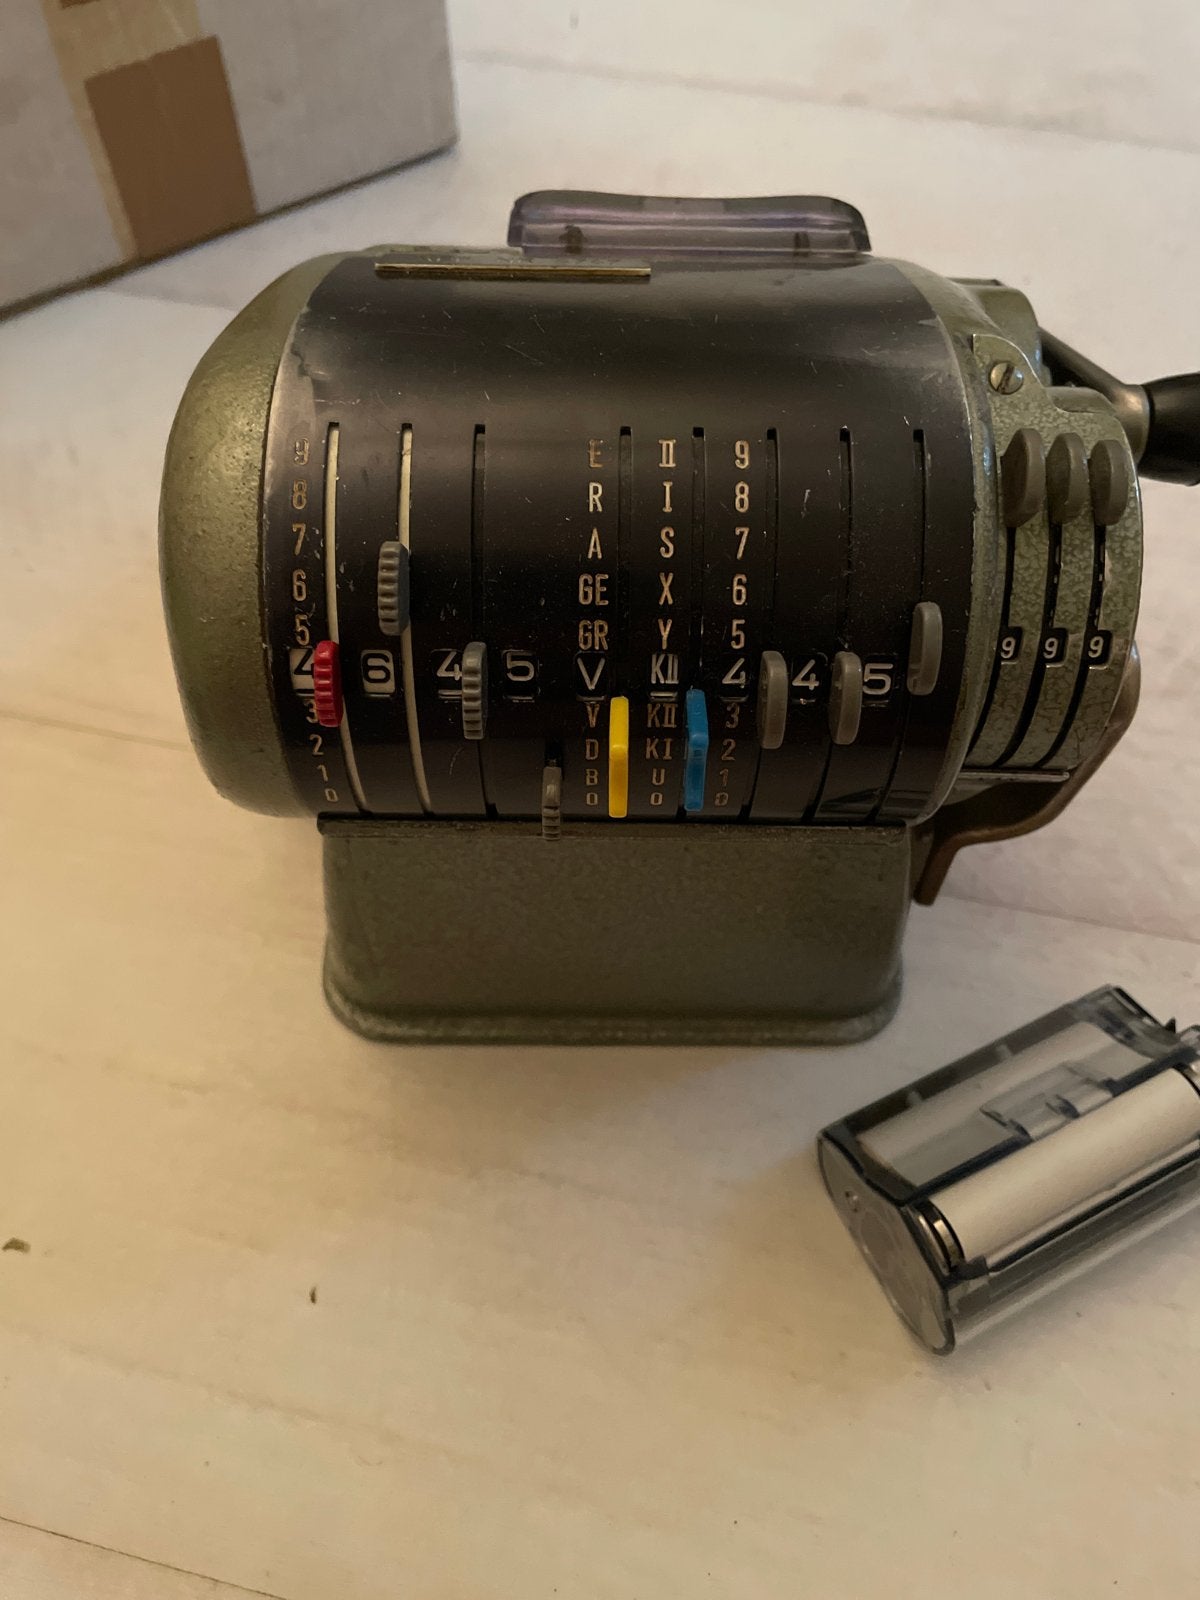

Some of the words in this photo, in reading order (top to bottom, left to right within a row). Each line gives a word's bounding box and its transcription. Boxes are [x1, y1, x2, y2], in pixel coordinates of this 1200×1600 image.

[293, 438, 310, 465] 9
[588, 439, 604, 468] E
[734, 440, 750, 469] 9
[292, 479, 308, 509] 8
[588, 482, 603, 512] R
[662, 480, 673, 513] I
[734, 480, 749, 513] 8
[292, 523, 306, 556] 7
[587, 527, 603, 559] A
[659, 526, 675, 558] S
[735, 527, 750, 560] 7
[292, 569, 307, 602] 6
[578, 573, 609, 606] GE
[658, 572, 674, 605] X
[732, 573, 747, 606] 6
[294, 614, 310, 646] 5
[578, 619, 609, 650] GR
[657, 618, 673, 650] Y
[730, 619, 746, 650] 5
[1000, 636, 1016, 659] 9
[1043, 637, 1059, 659] 9
[1088, 635, 1104, 658] 9
[363, 653, 391, 683] 6
[436, 651, 463, 681] 4
[506, 651, 535, 681] 5
[577, 657, 606, 690] V
[721, 658, 747, 688] 4
[791, 659, 820, 691] 4
[862, 663, 894, 695] 5
[584, 702, 600, 728] V
[725, 702, 740, 728] 3
[309, 734, 323, 756] 2
[585, 738, 599, 760] D
[721, 738, 736, 761] 2
[317, 764, 328, 782] 1
[585, 768, 599, 786] B
[651, 768, 666, 786] U
[719, 768, 729, 787] 1
